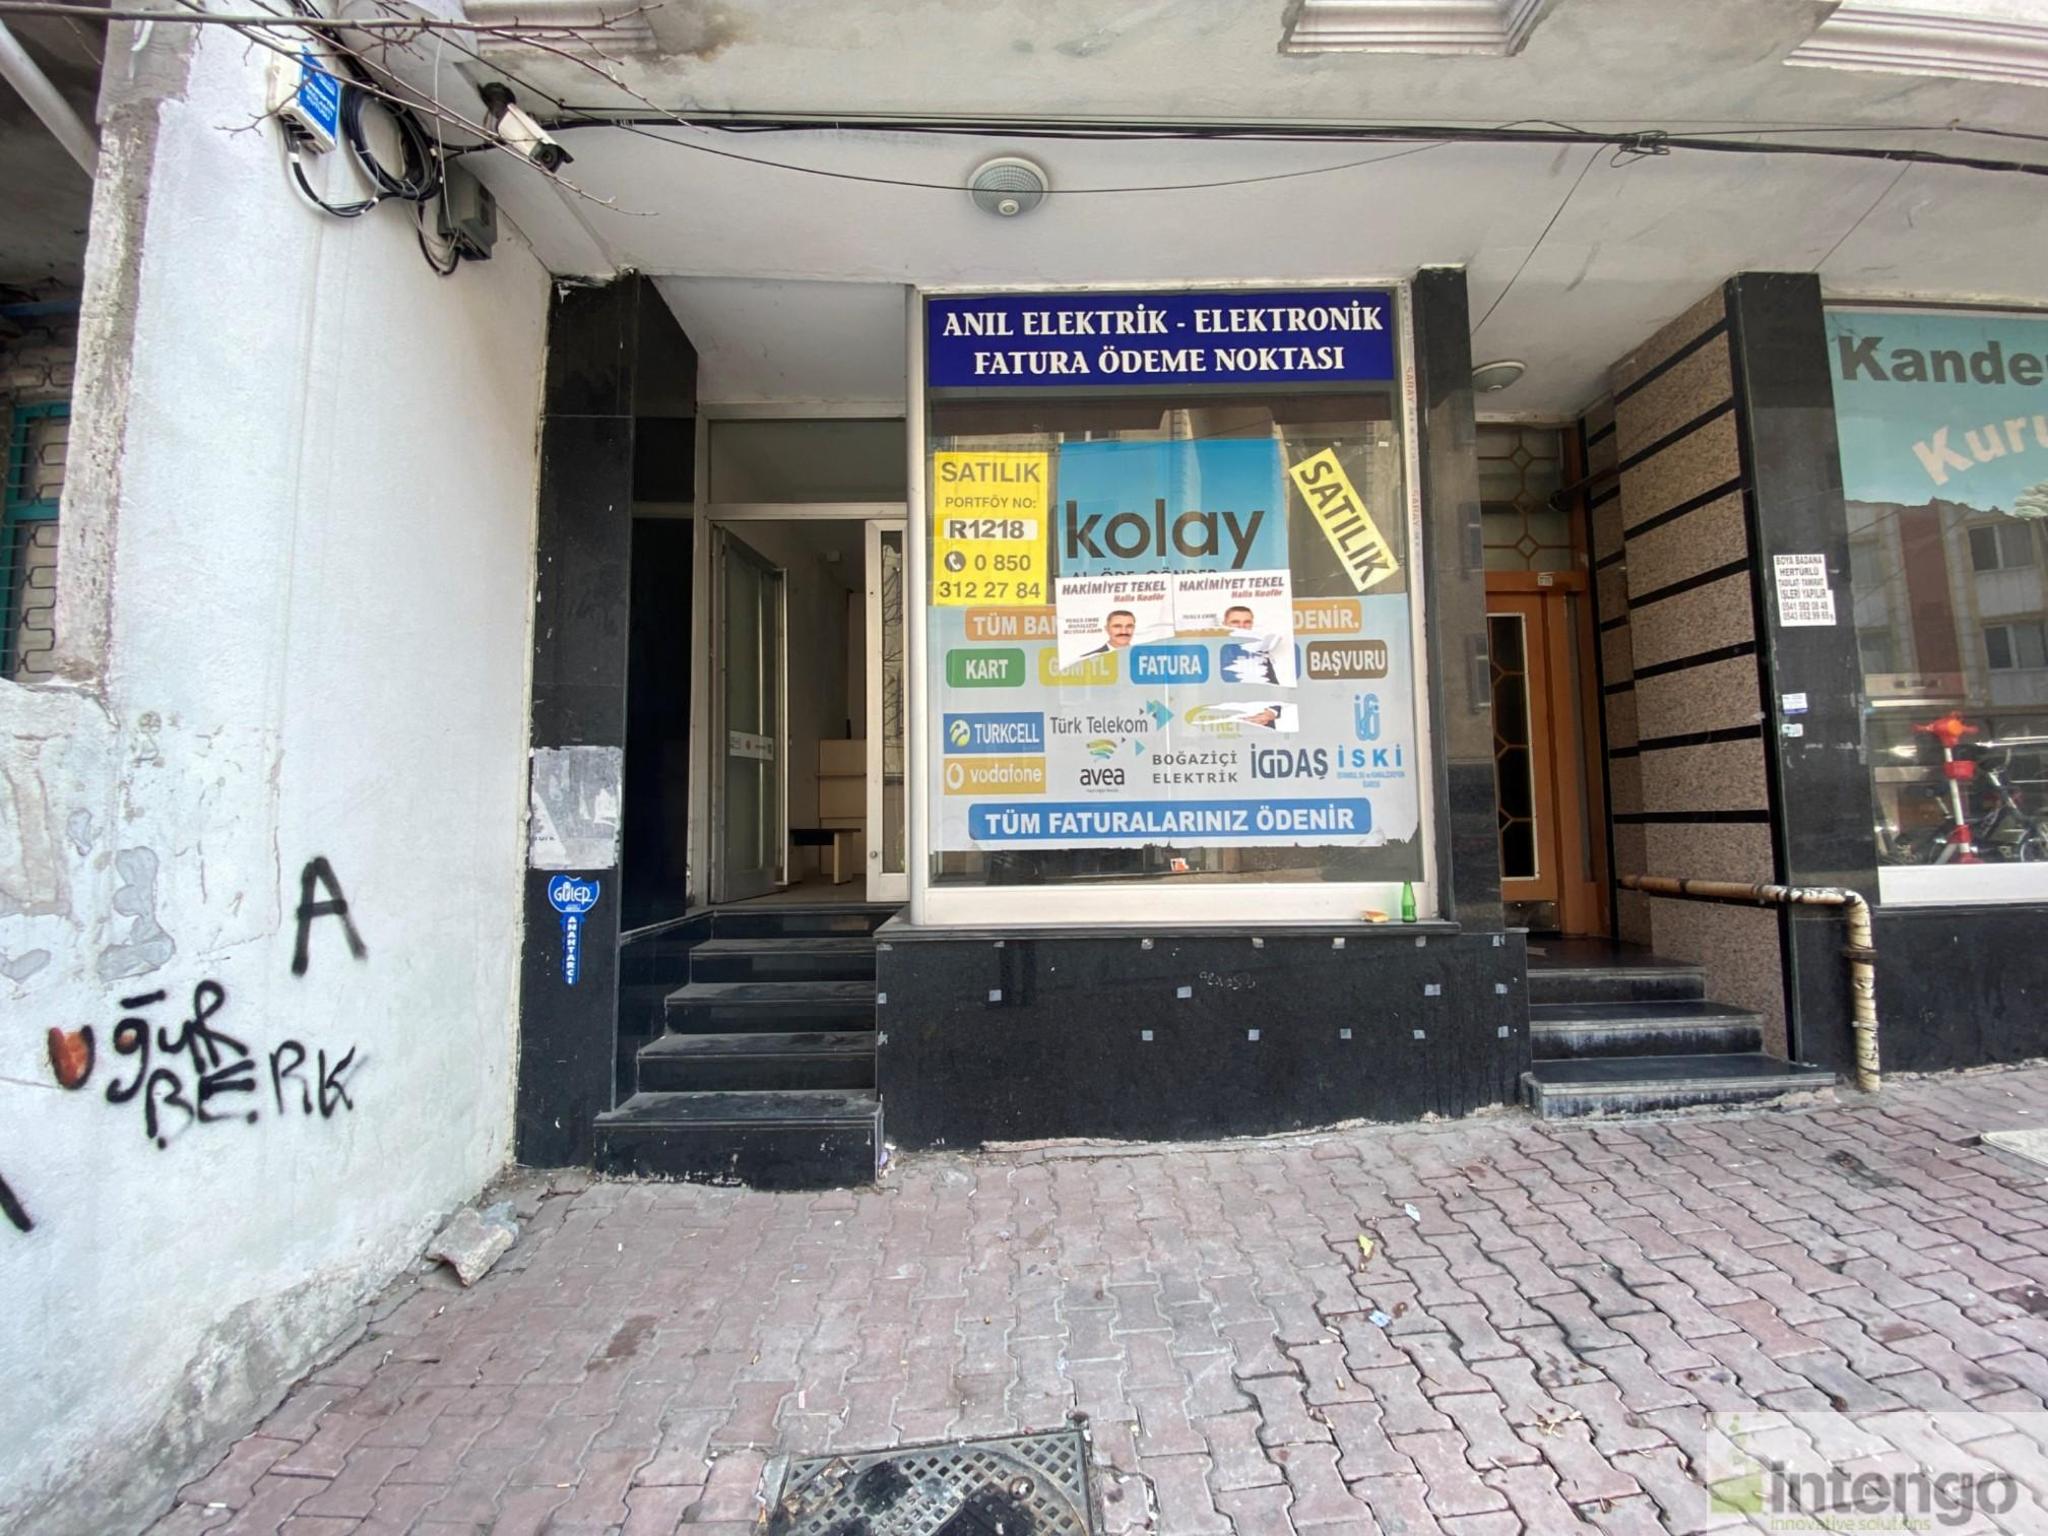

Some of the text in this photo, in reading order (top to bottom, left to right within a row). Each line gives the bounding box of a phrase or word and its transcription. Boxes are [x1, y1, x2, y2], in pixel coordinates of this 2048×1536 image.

[943, 311, 1013, 337] ANIL
[1024, 304, 1168, 335] ELEKTRİK
[1194, 300, 1383, 333] ELEKTRONİK
[974, 345, 1345, 375] FATURA ÖDEME NOKTASI
[1838, 336, 2048, 386] Kande
[941, 462, 1040, 483] SATILIK
[945, 495, 1037, 509] PORTFÖY NO:
[949, 520, 1024, 539] R1218
[1301, 461, 1390, 584] SATILIK
[1066, 499, 1265, 570] kolay
[974, 554, 1031, 572] 0 850
[939, 581, 1041, 598] 312 27 84
[1062, 580, 1166, 595] HAKİMİYET TEKEL
[1179, 577, 1284, 591] HAKİMİYET TEKEL
[973, 613, 1018, 636] TÜM
[1293, 604, 1359, 629] DENİR.
[965, 658, 1010, 680] KART
[1138, 654, 1203, 676] FATURA
[1310, 650, 1385, 676] BAŞVURU
[975, 723, 1040, 744] TURKCELL
[1050, 716, 1148, 735] Türk Telekom
[1152, 750, 1238, 767] BOĞAZİÇİ
[1251, 744, 1328, 780] İGDAŞ
[1338, 744, 1402, 768] İSKİ
[970, 764, 1042, 783] vodafone
[1080, 768, 1125, 786] avea
[1153, 769, 1238, 784] ELEKTRİK
[985, 804, 1354, 834] TÜM FATURALARINIZ ÖDENİR
[291, 857, 367, 977] A
